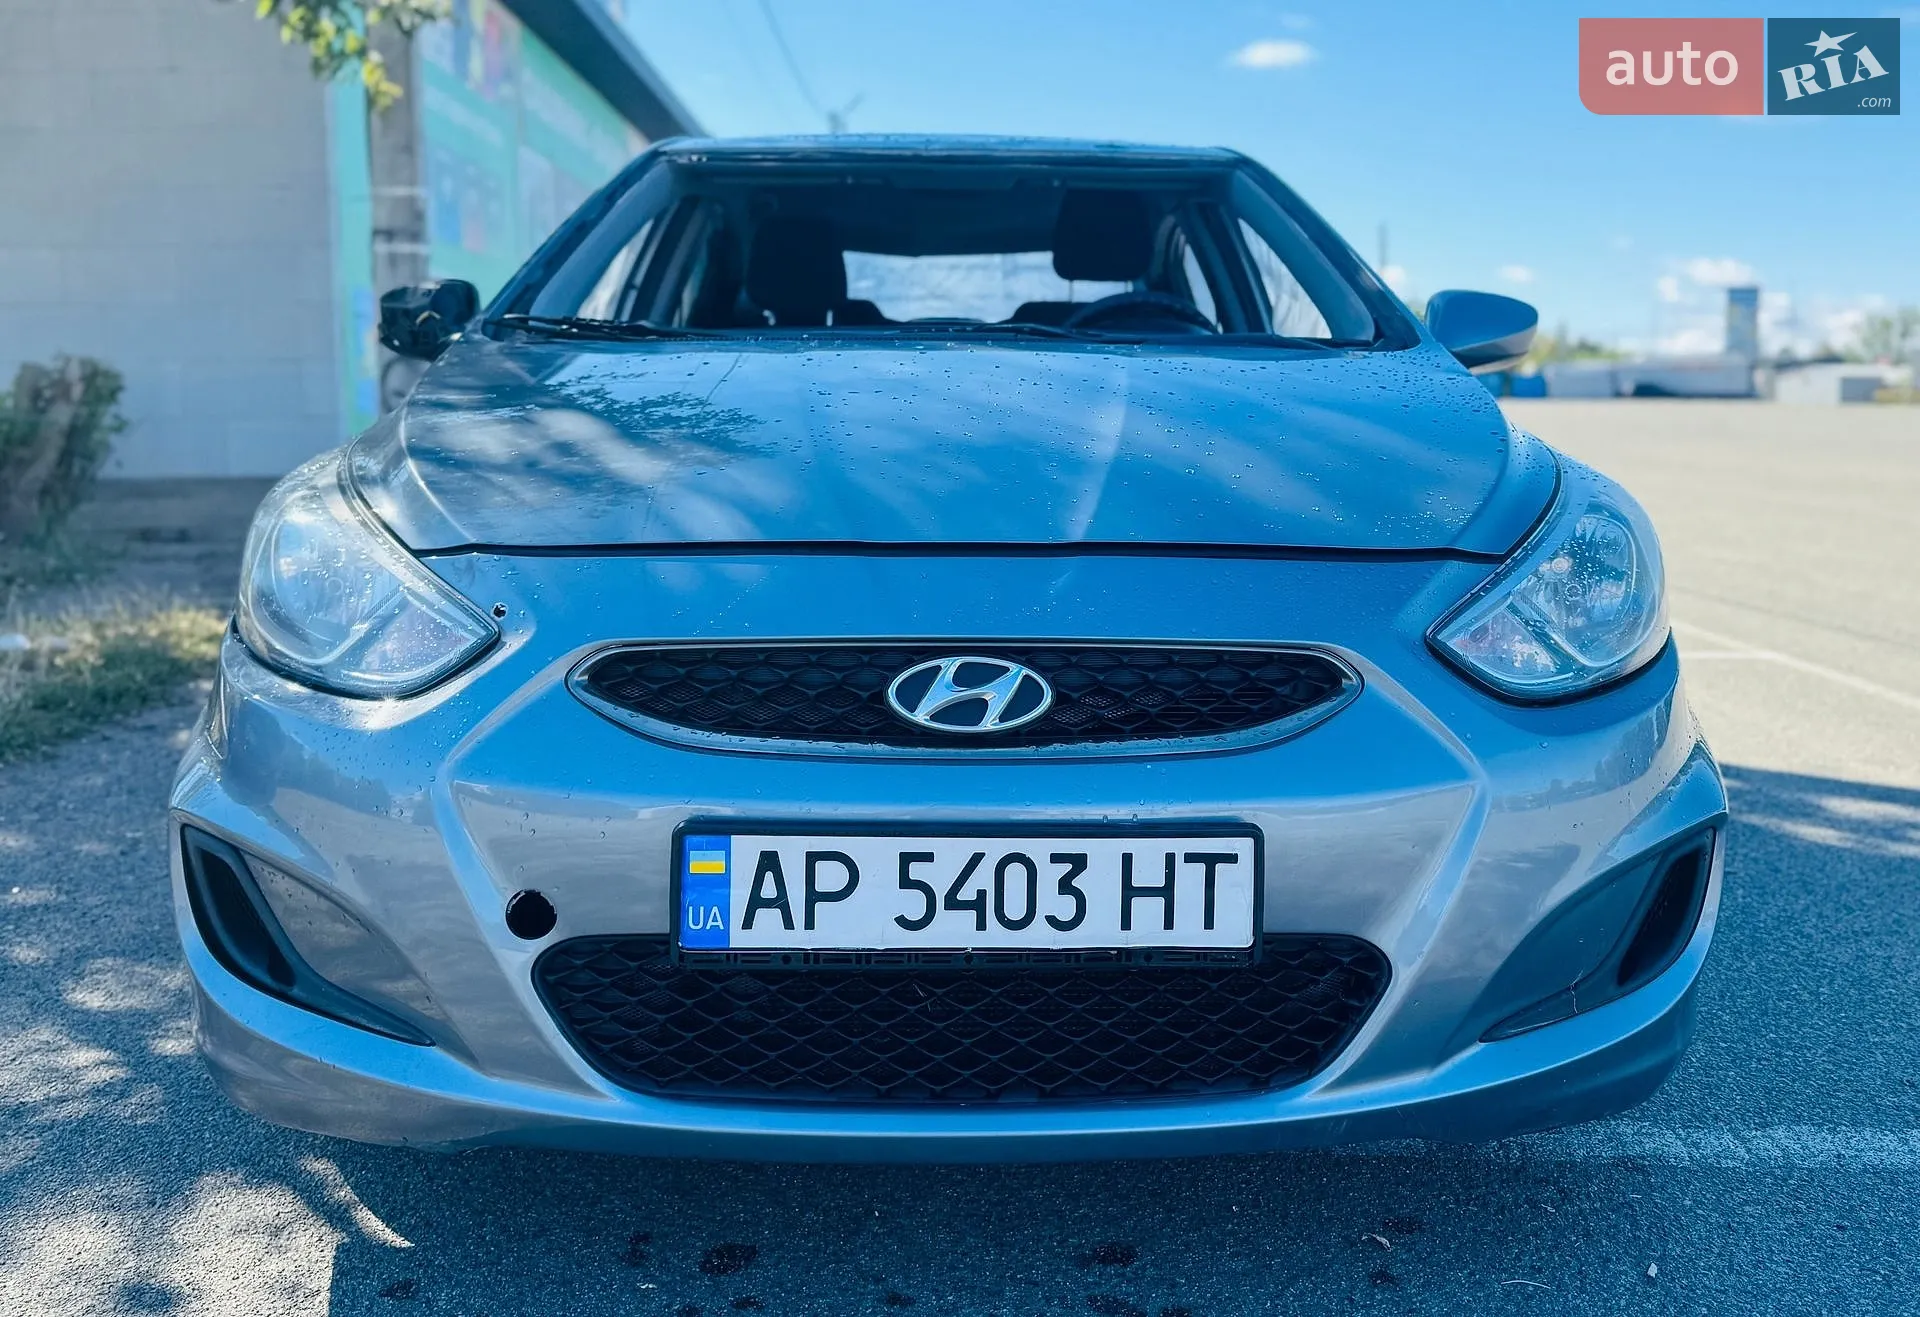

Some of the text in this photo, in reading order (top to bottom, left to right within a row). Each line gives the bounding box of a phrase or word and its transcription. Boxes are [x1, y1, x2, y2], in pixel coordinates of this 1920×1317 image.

[687, 905, 725, 930] UA
[741, 850, 1239, 932] AP 5403 HT
